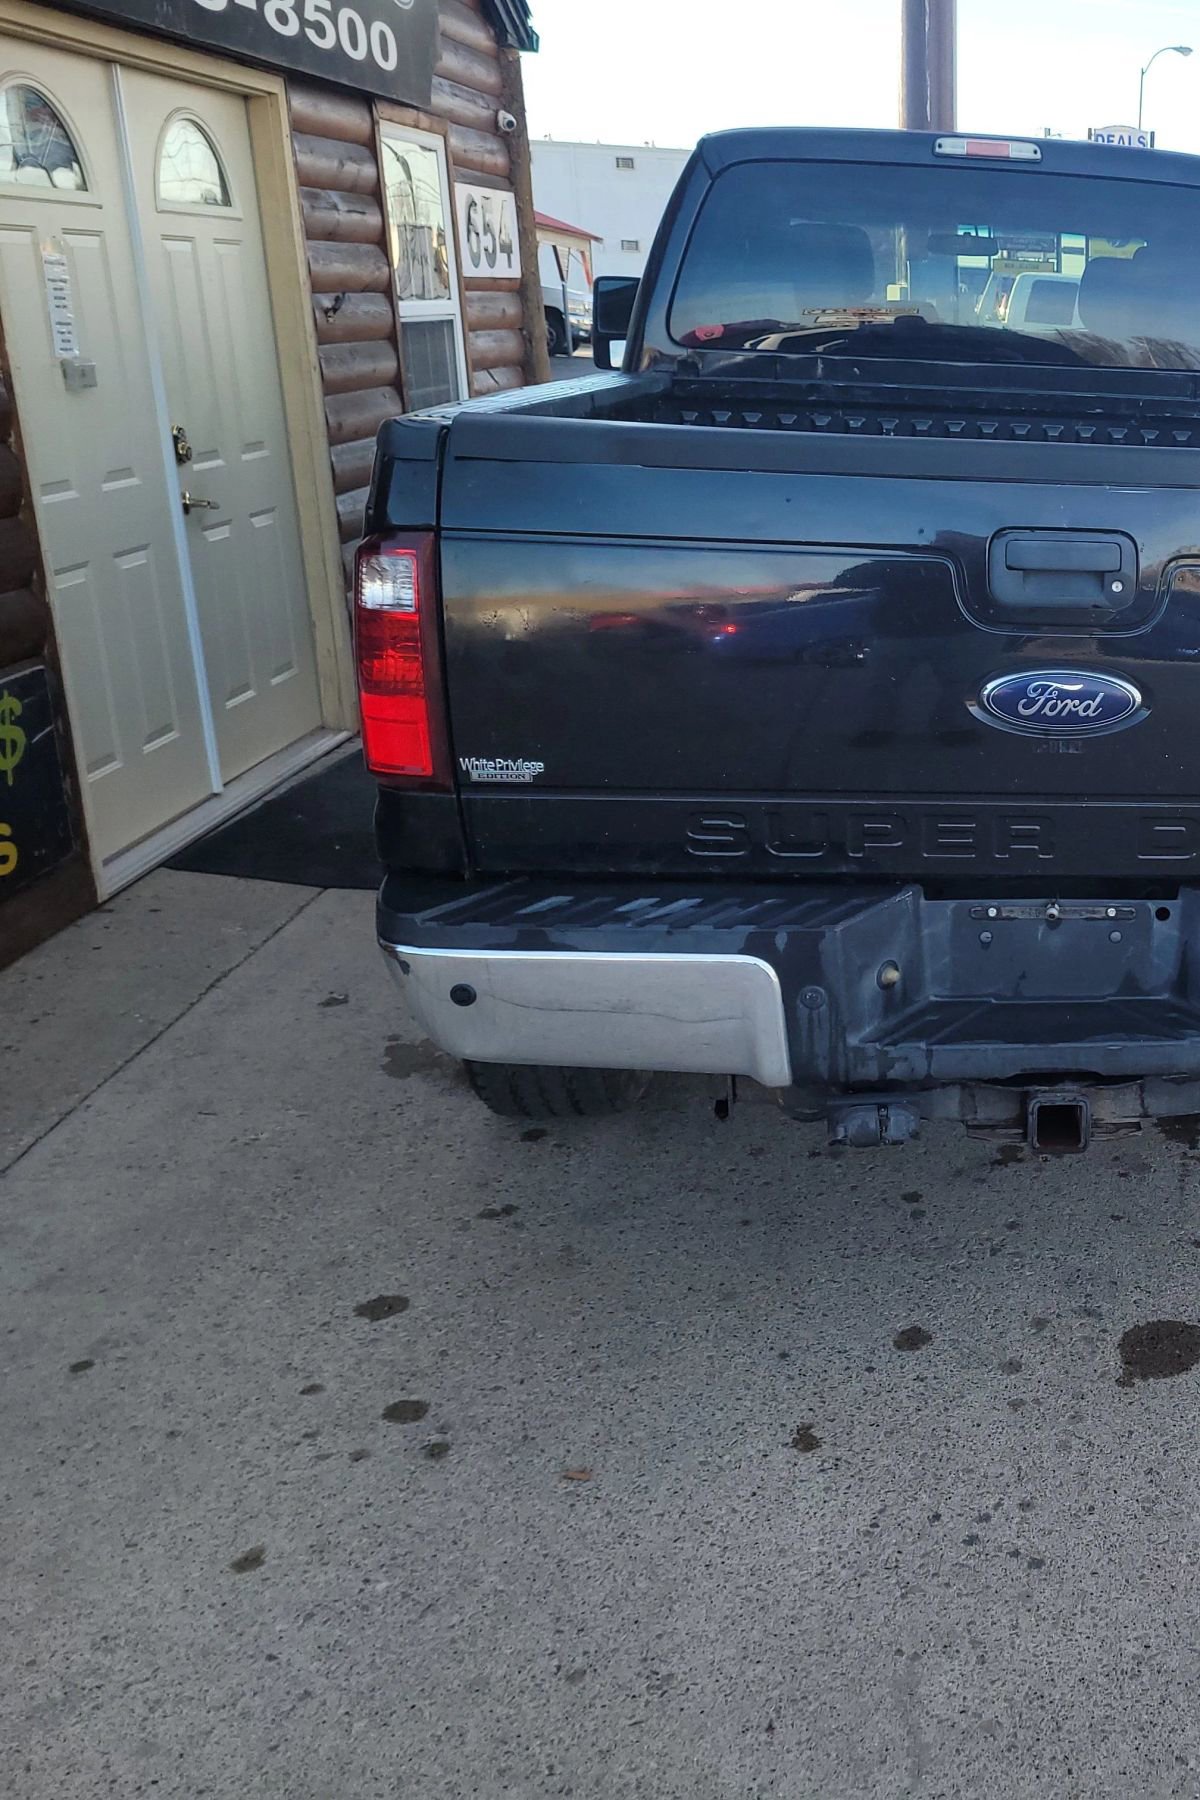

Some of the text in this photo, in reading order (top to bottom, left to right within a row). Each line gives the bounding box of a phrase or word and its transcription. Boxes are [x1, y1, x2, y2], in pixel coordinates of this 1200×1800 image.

[194, 0, 398, 71] -8500
[465, 192, 513, 269] 654
[1018, 681, 1105, 717] Ford
[495, 758, 544, 775] Privilege
[686, 811, 1056, 859] SUPER
